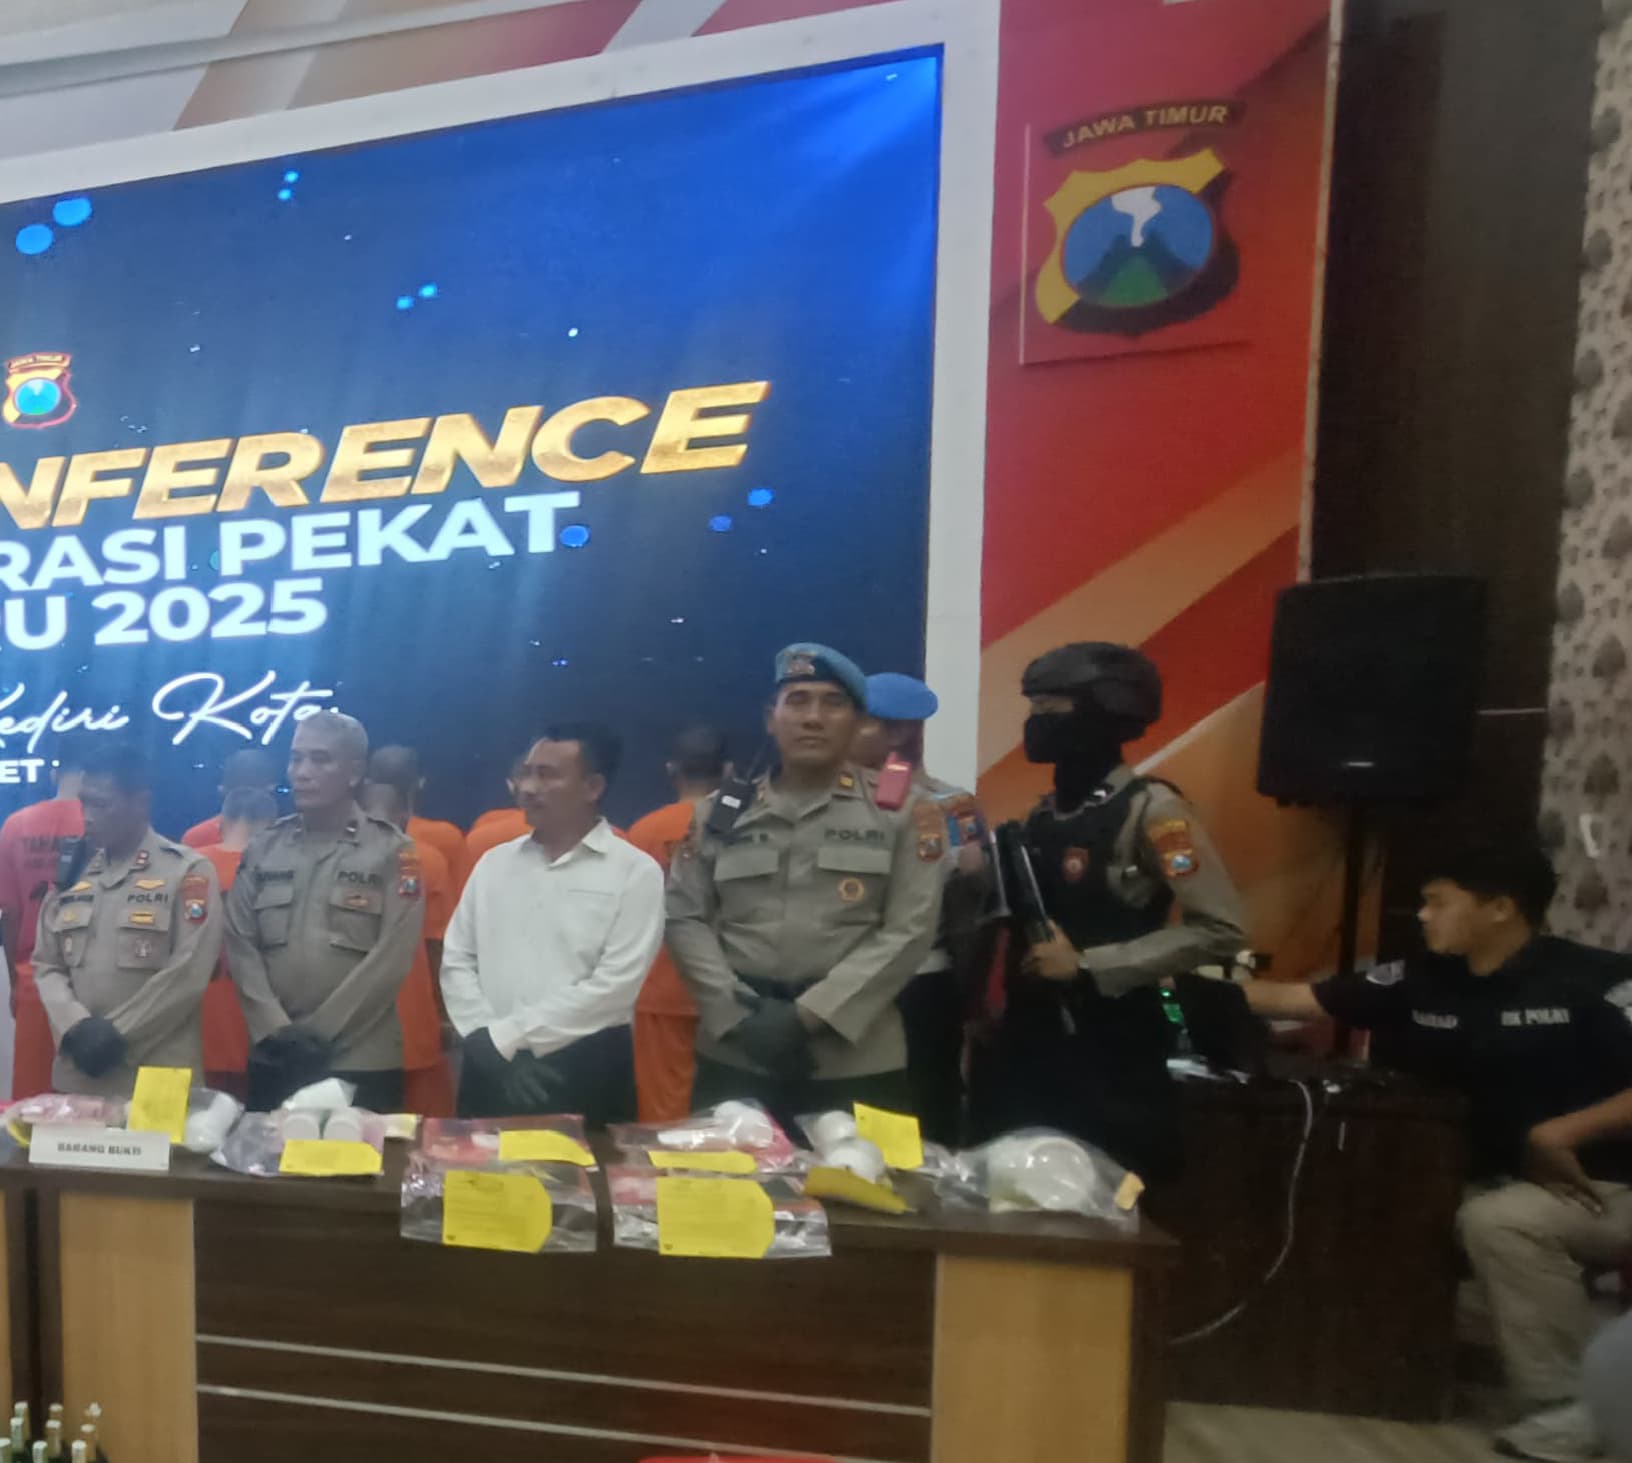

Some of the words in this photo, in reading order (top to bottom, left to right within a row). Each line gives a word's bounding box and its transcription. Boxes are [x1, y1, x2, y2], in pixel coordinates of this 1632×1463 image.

[1063, 114, 1135, 148] JAWA
[1144, 105, 1229, 126] TIMUR
[219, 491, 581, 577] PEKAT
[93, 578, 328, 646] 2025
[824, 829, 885, 842] POLRI
[127, 893, 169, 903] POLRI
[57, 1142, 105, 1154] BARANG
